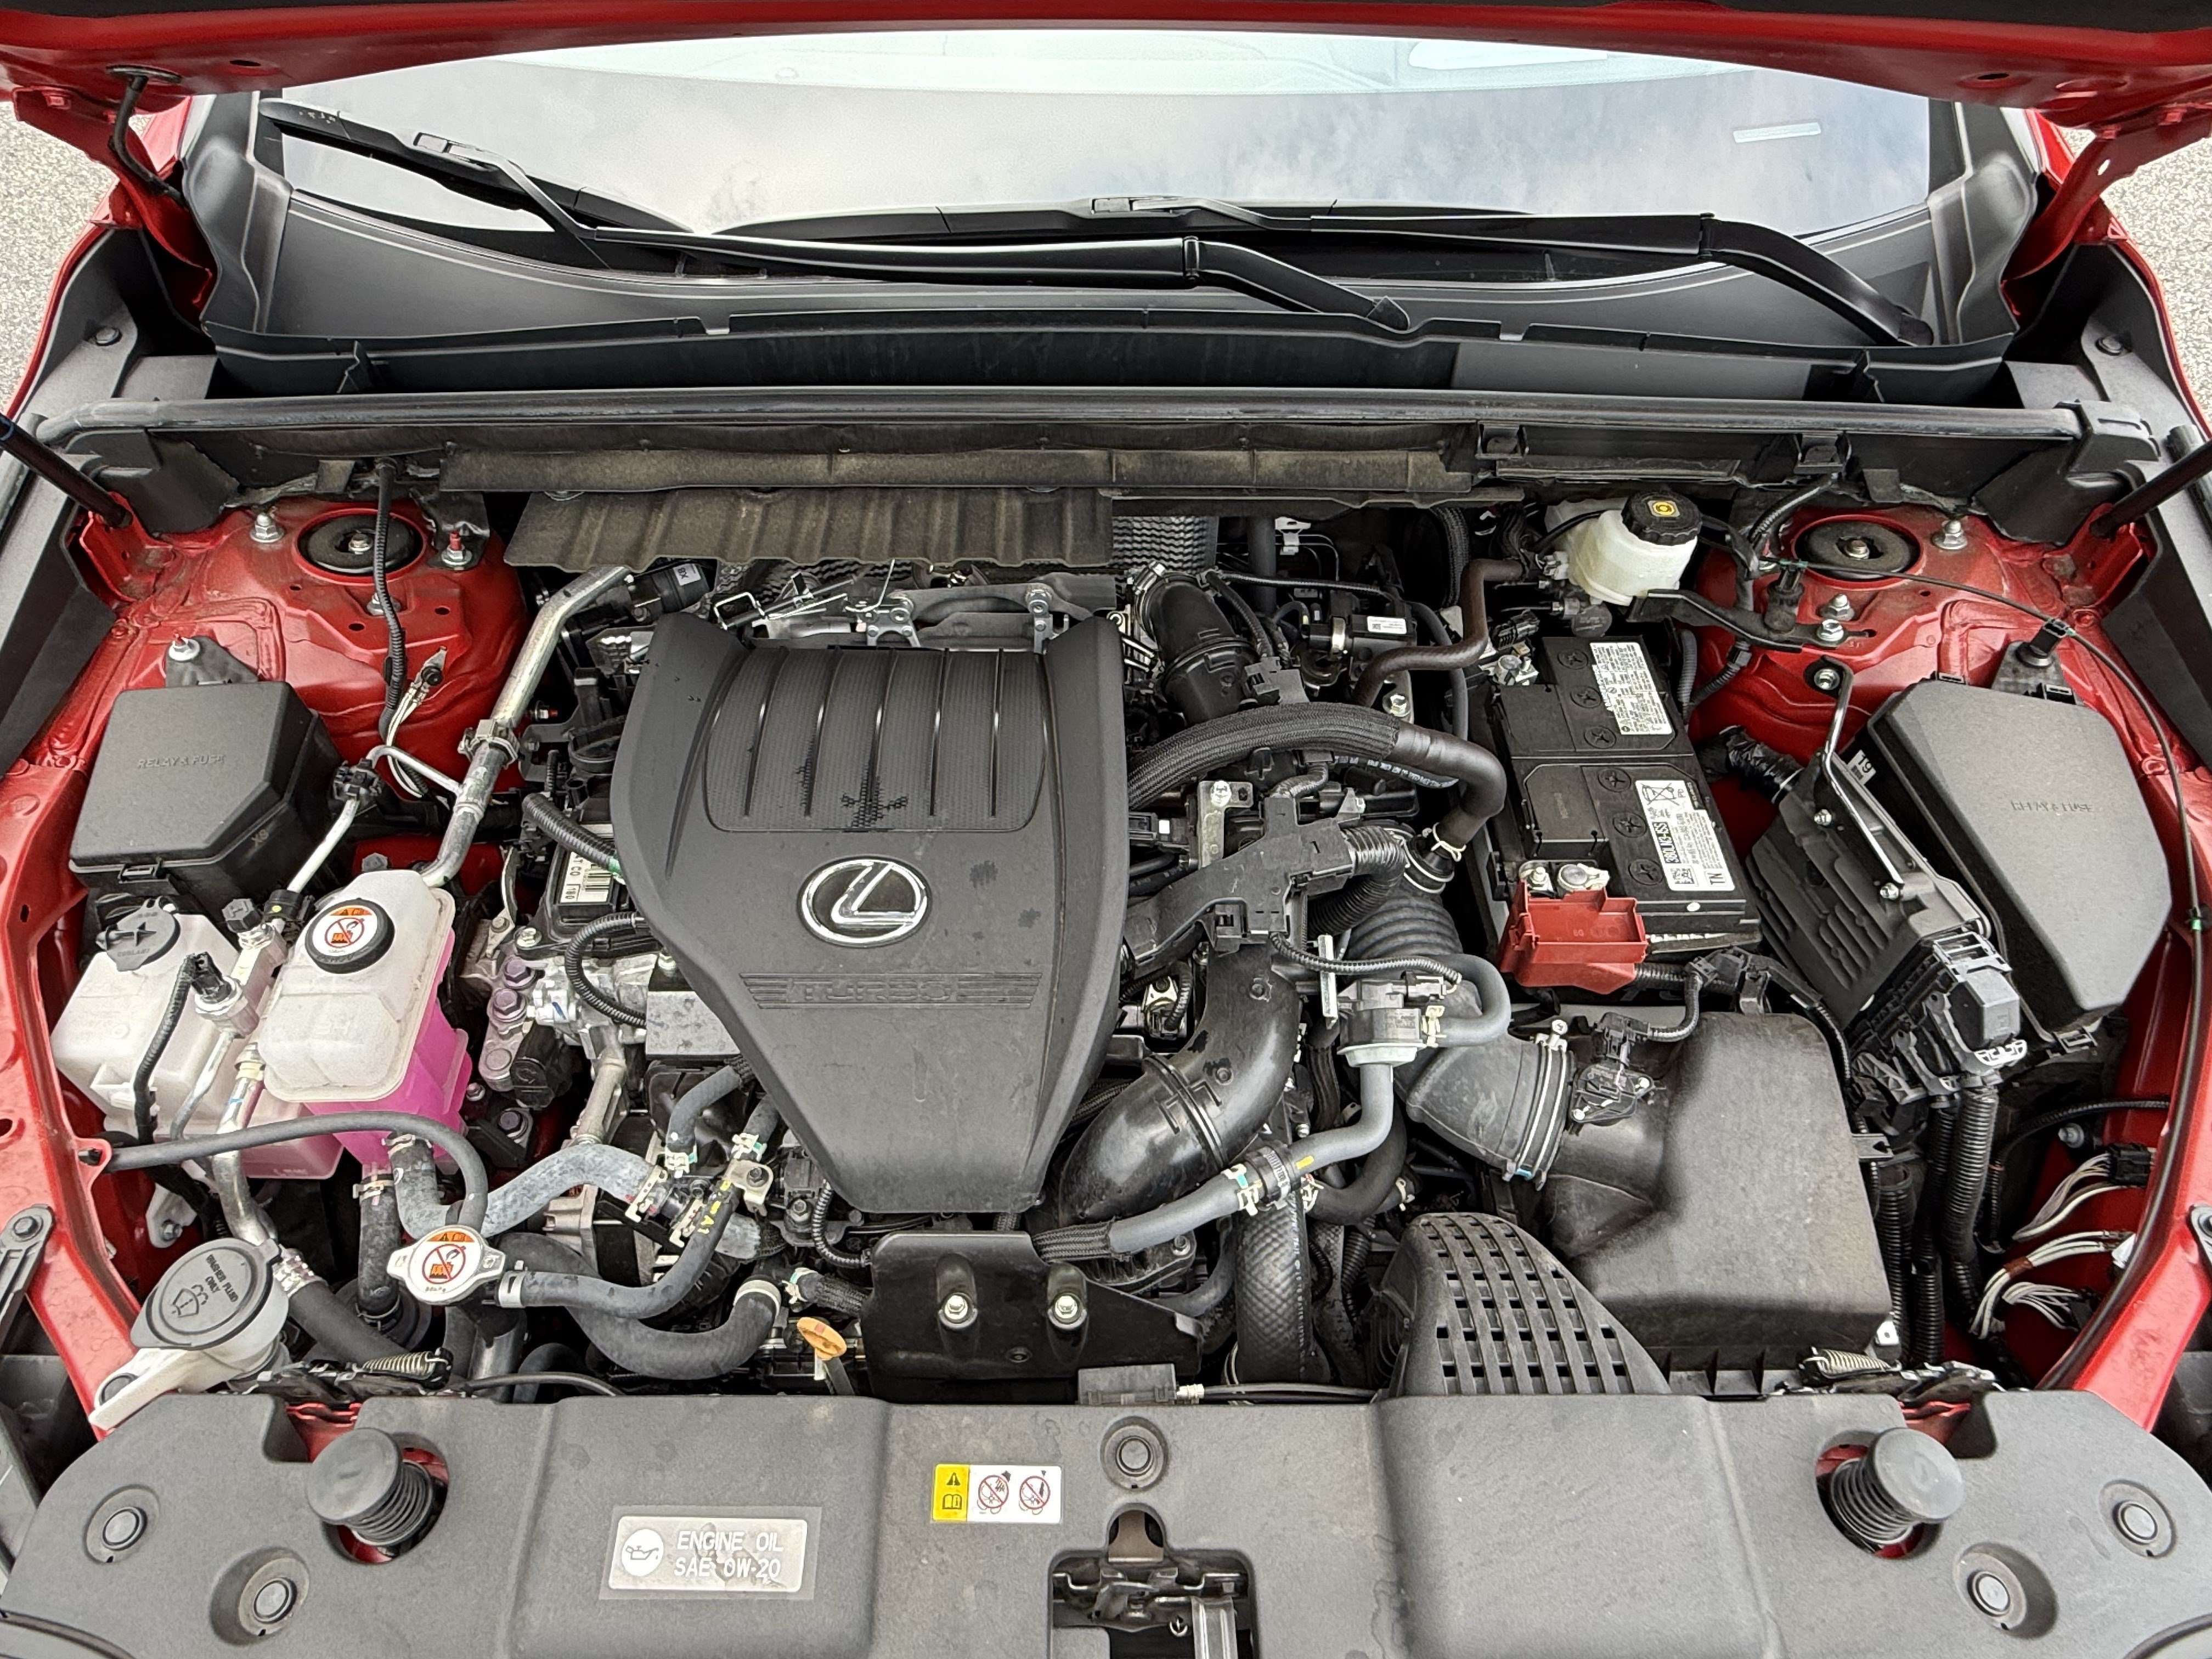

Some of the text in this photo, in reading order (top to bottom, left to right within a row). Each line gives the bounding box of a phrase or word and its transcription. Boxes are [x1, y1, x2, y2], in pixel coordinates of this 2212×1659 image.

[138, 757, 180, 769] RELAY
[205, 1276, 220, 1294] ONLY
[206, 1254, 239, 1302] WASHER FLUID
[676, 1530, 785, 1552] ENGINE OIL
[673, 1556, 782, 1579] SAE 0W-20
